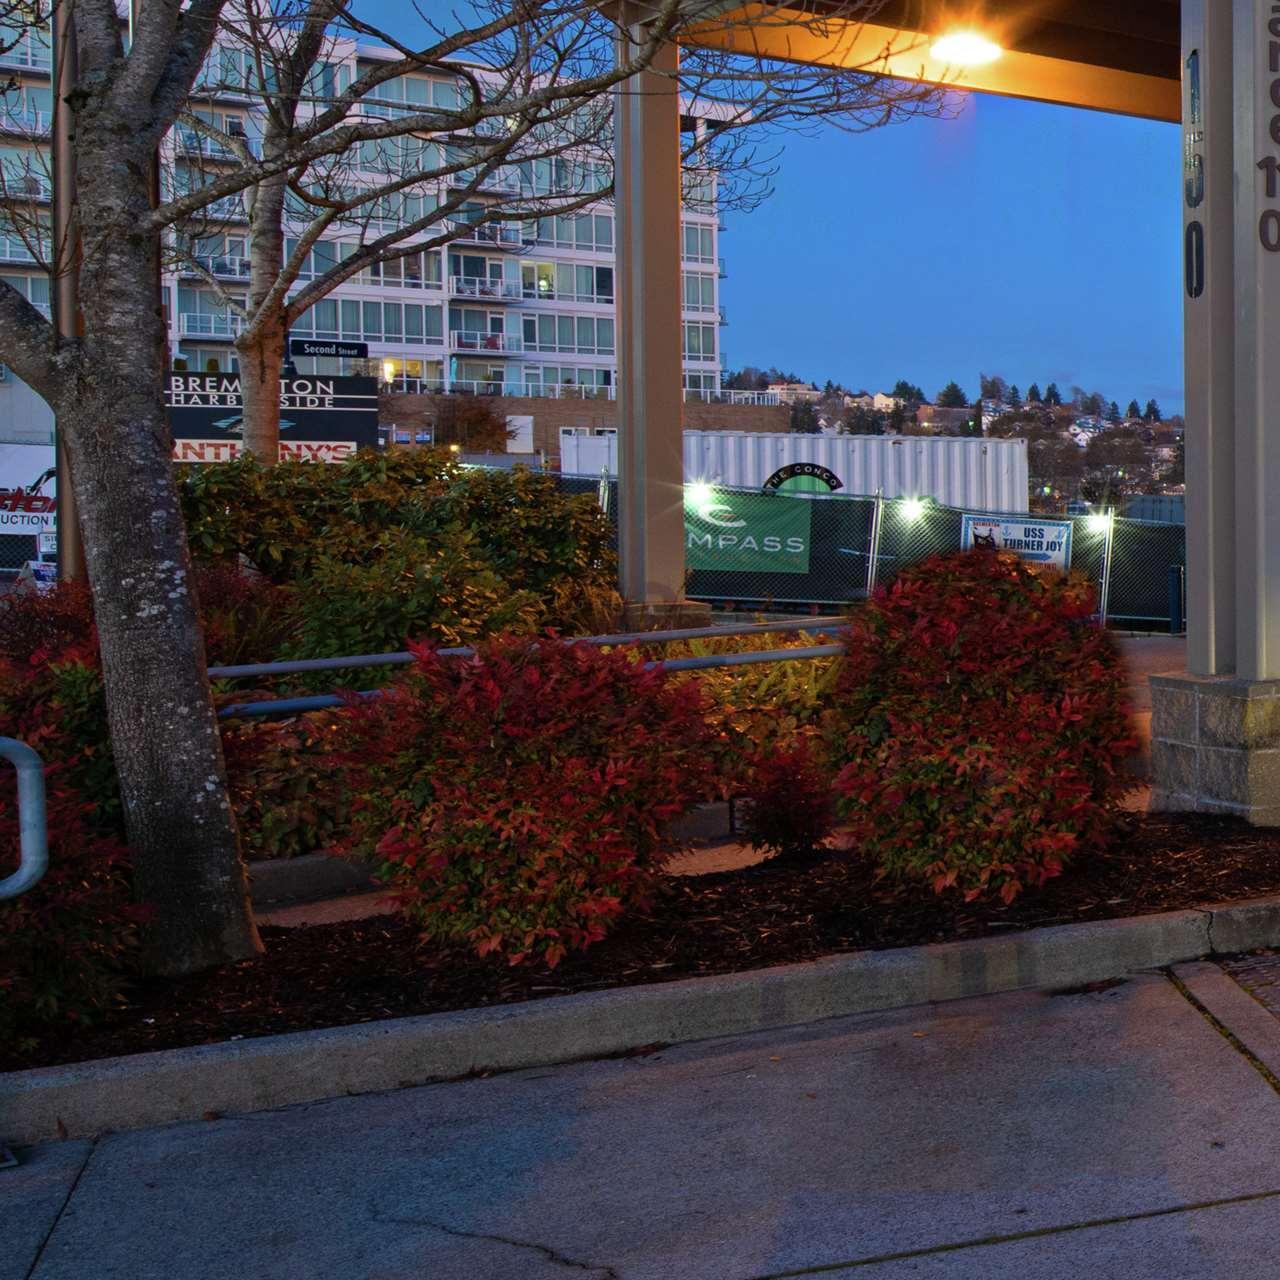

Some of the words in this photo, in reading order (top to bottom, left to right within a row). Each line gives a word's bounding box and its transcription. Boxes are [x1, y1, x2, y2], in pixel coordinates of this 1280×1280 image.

[304, 343, 336, 355] Second
[171, 376, 334, 396] BREMTON
[171, 392, 334, 408] HARBSIDE
[1023, 527, 1045, 540] USS
[687, 533, 805, 553] MPASS
[1002, 538, 1044, 552] TURNER
[1045, 540, 1064, 553] JOY
